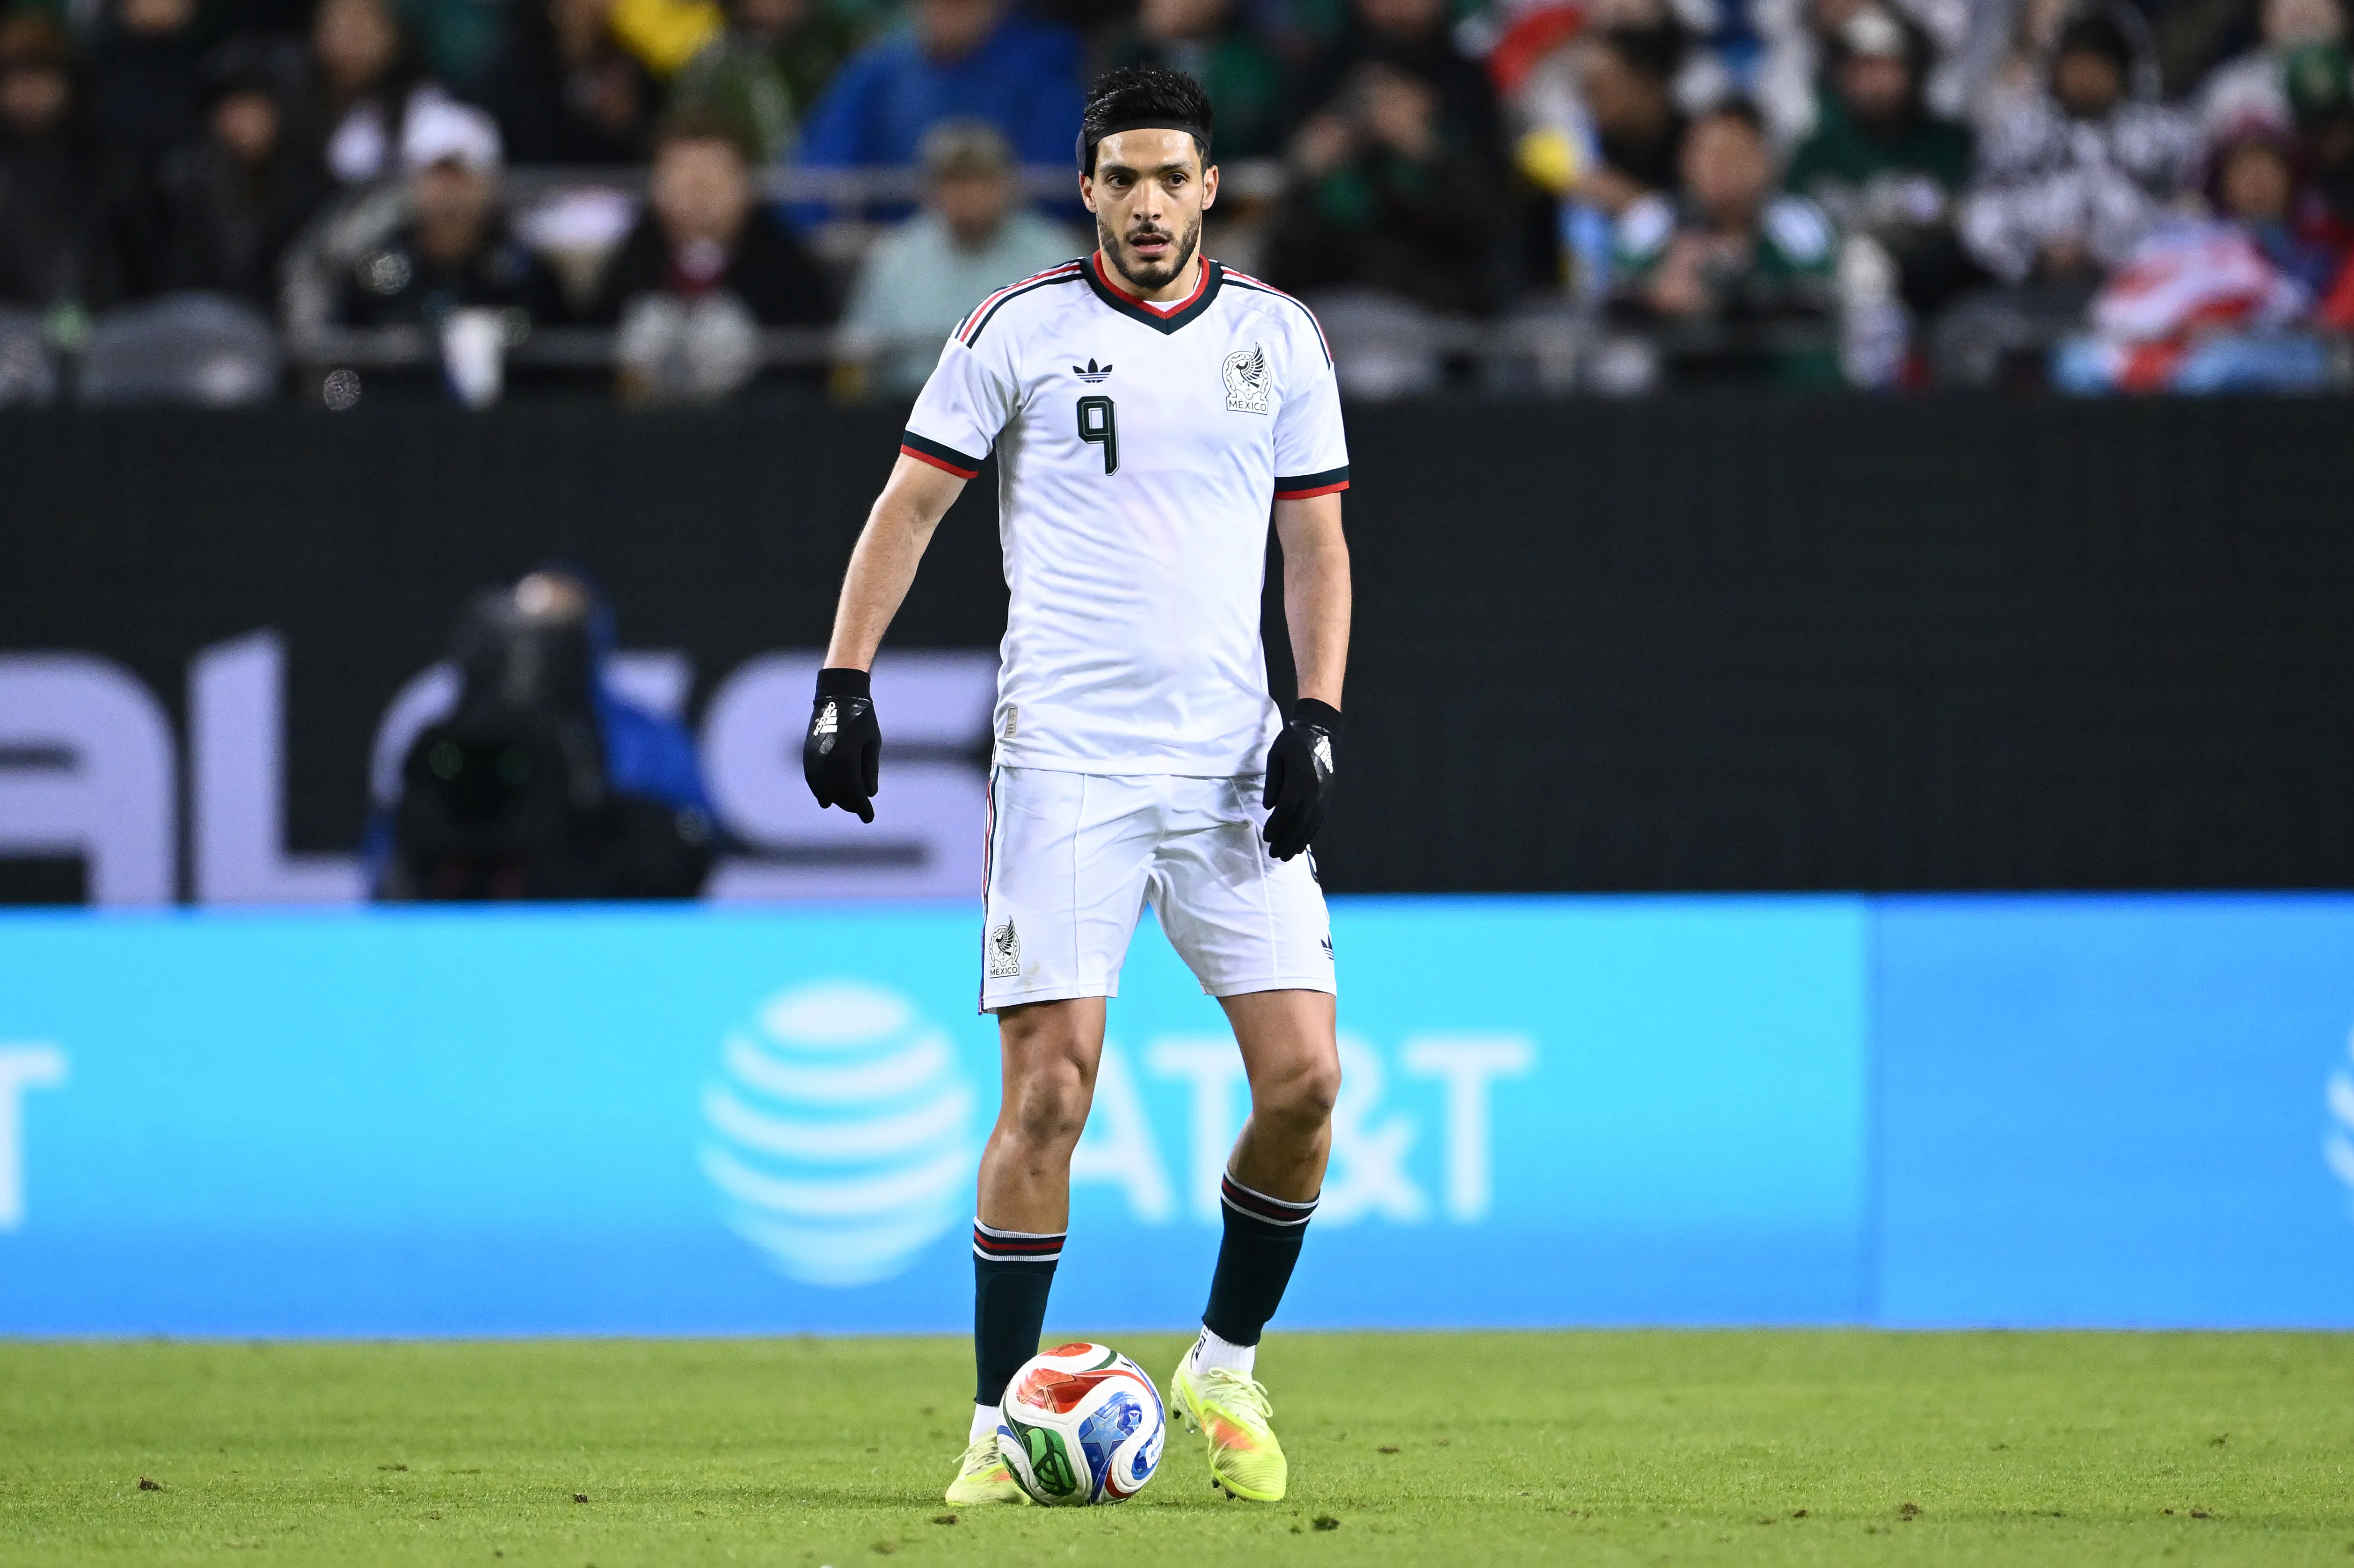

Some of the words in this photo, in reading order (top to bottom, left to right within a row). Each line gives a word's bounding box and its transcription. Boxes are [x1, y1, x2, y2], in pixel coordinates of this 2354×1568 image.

[1229, 398, 1267, 412] MÉXICO
[1077, 396, 1120, 476] 9
[813, 702, 836, 736] adidas
